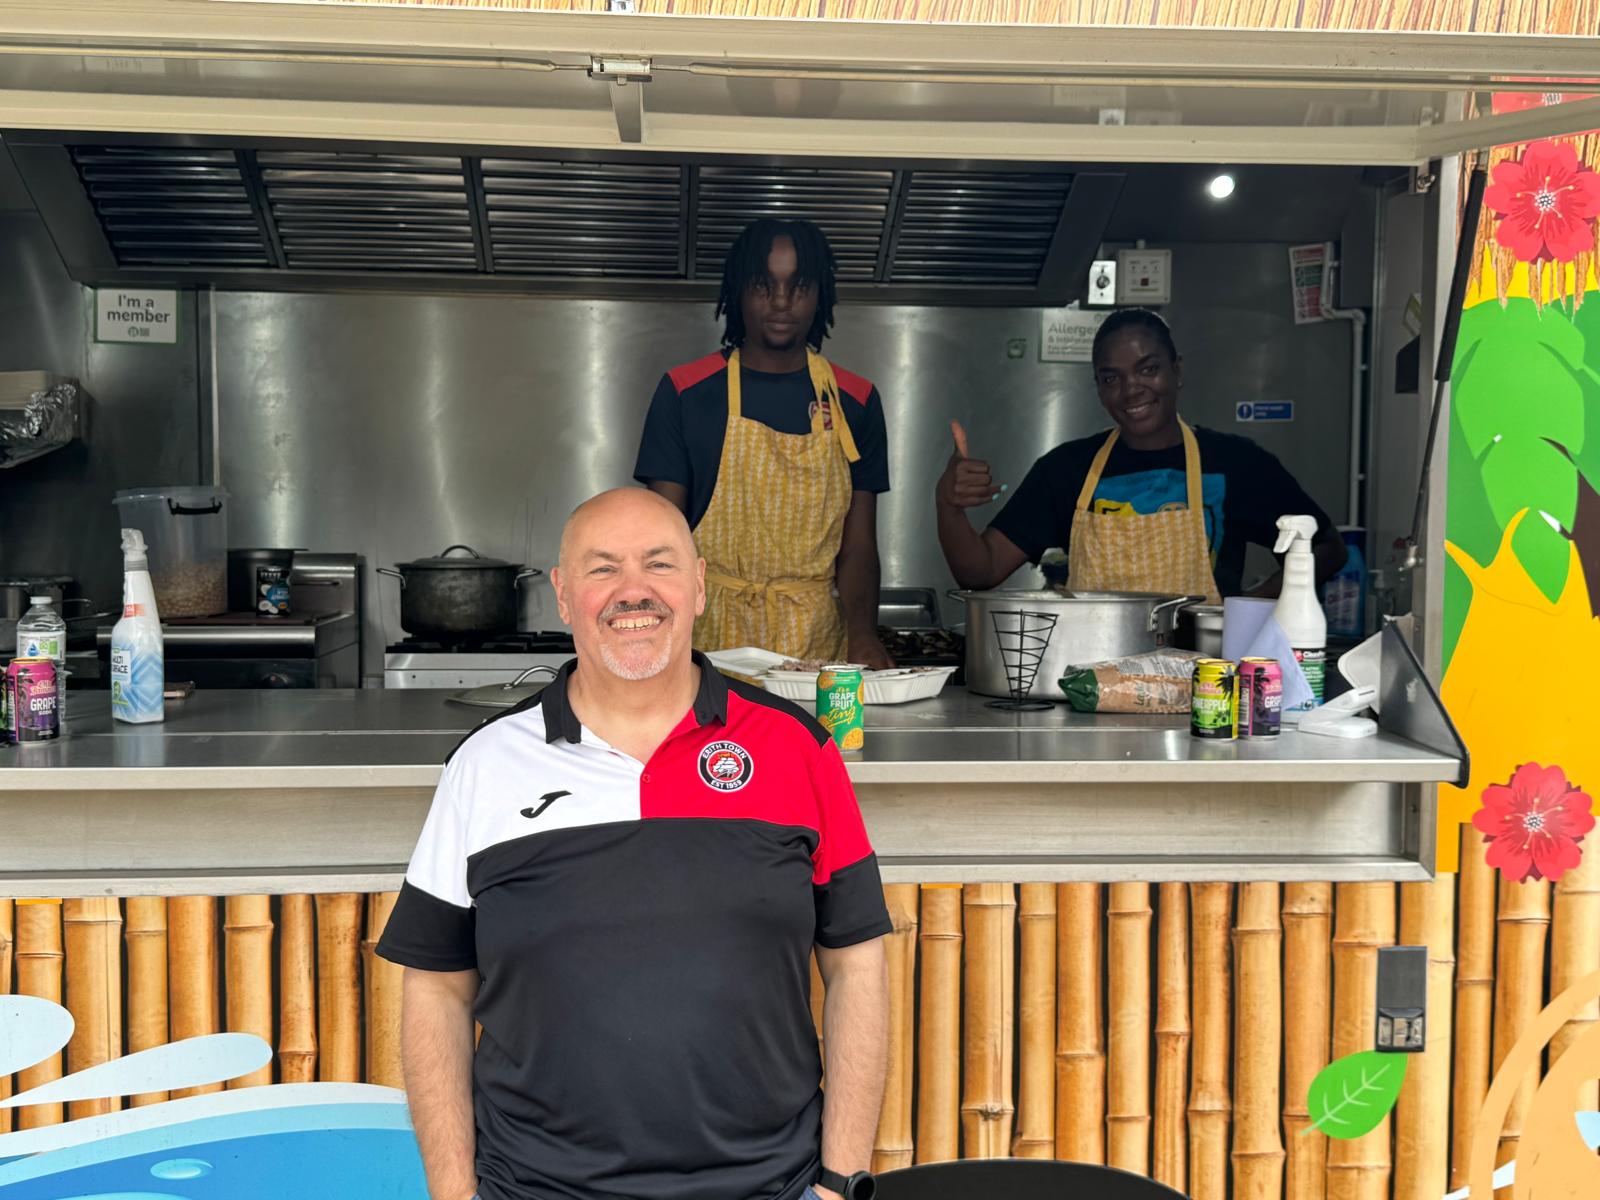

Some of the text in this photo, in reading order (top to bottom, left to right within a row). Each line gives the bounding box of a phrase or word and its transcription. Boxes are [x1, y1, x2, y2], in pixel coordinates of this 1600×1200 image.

[118, 294, 154, 308] I'm a
[107, 309, 170, 323] member
[829, 692, 856, 700] GRAPE
[1265, 695, 1282, 709] GRAP
[30, 696, 56, 712] GRAPE
[830, 700, 853, 710] FRUIT
[702, 743, 747, 759] ERITH TOWN
[711, 779, 724, 789] EST
